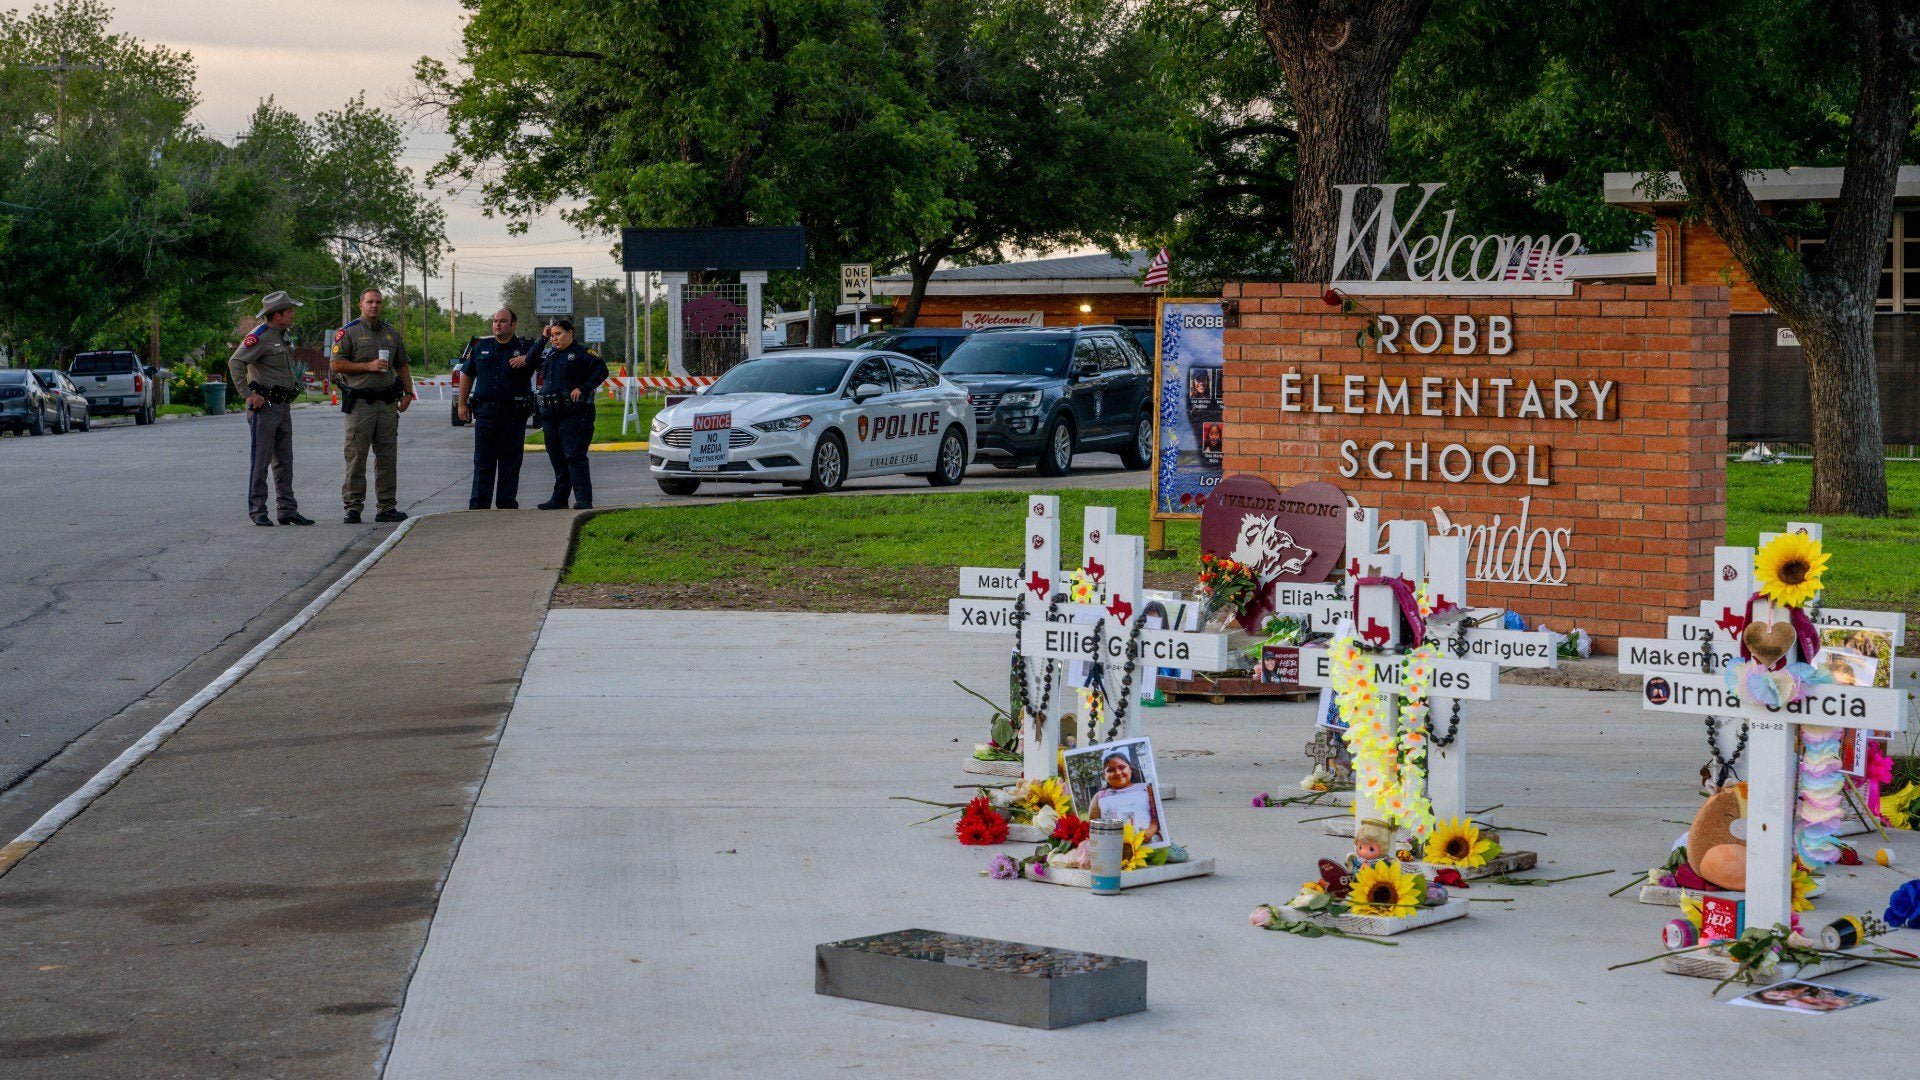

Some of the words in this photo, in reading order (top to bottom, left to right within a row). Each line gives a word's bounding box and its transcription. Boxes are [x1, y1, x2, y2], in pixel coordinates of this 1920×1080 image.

[1332, 183, 1581, 282] Welcome
[845, 268, 868, 277] ONE
[845, 279, 868, 287] WAY
[973, 313, 1034, 324] Welcome!
[1377, 315, 1514, 355] ROBB
[1281, 374, 1613, 420] ELEMENTARY
[695, 415, 730, 430] NOTICE
[871, 411, 940, 441] POLICE
[707, 433, 718, 443] NO
[700, 444, 722, 454] MEDIA
[870, 456, 899, 467] UVALDE
[902, 454, 918, 463] CISD
[1339, 440, 1549, 486] SCHOOL
[1278, 499, 1340, 517] STRONG
[1046, 631, 1097, 654] Ellie
[1374, 663, 1470, 690] Miles
[1674, 682, 1740, 708] Irma
[1766, 693, 1866, 718] arcia
[1751, 723, 1784, 731] 5-24-22
[1707, 913, 1732, 927] HELP
